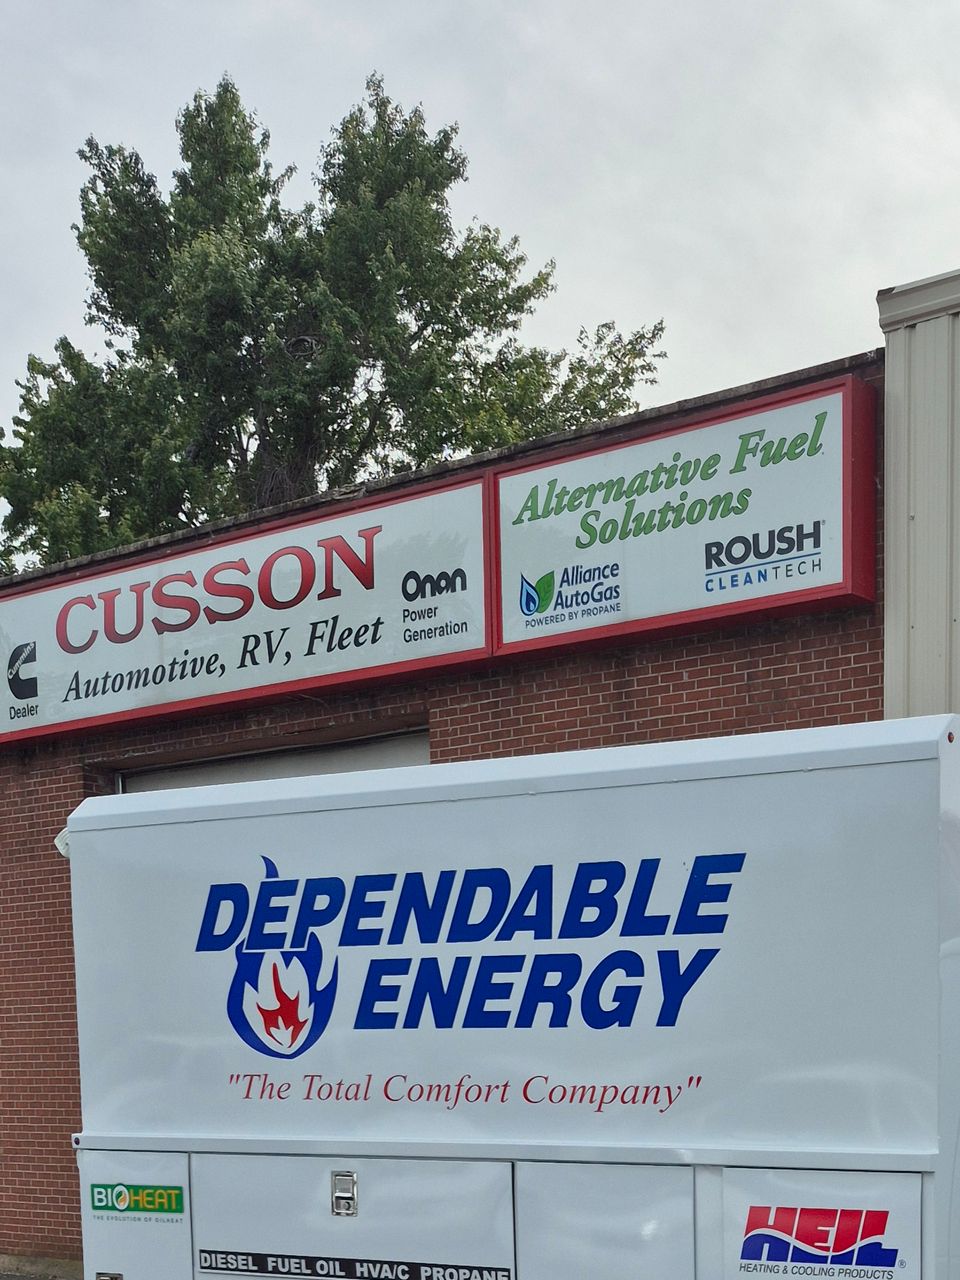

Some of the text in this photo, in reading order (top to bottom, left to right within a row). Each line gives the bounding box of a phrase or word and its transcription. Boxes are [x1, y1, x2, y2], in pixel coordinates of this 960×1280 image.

[512, 411, 828, 526] Alternative Fuel
[575, 487, 753, 550] Solutions
[55, 525, 383, 655] CUSSON
[401, 567, 468, 602] Onan
[559, 562, 620, 588] Alliance
[553, 582, 621, 612] AutoGas
[402, 605, 438, 623] Power
[525, 602, 622, 629] POWERED BY PROPANE
[403, 620, 468, 644] Generation
[7, 641, 36, 680] Cummins
[62, 614, 385, 704] Automotive, RV, Fleet
[9, 703, 39, 720] Dealer
[195, 853, 747, 953] DEPENDABLE
[353, 948, 721, 1030] ENERGY
[228, 1074, 702, 1114] "The Total Comfort Company"
[93, 1184, 179, 1210] BIOHEAT
[200, 1252, 258, 1271] DIESEL
[267, 1257, 312, 1275] FUEL
[316, 1259, 346, 1277] OIL
[739, 1263, 894, 1280] HEATING & COOLING PRODUCTS
